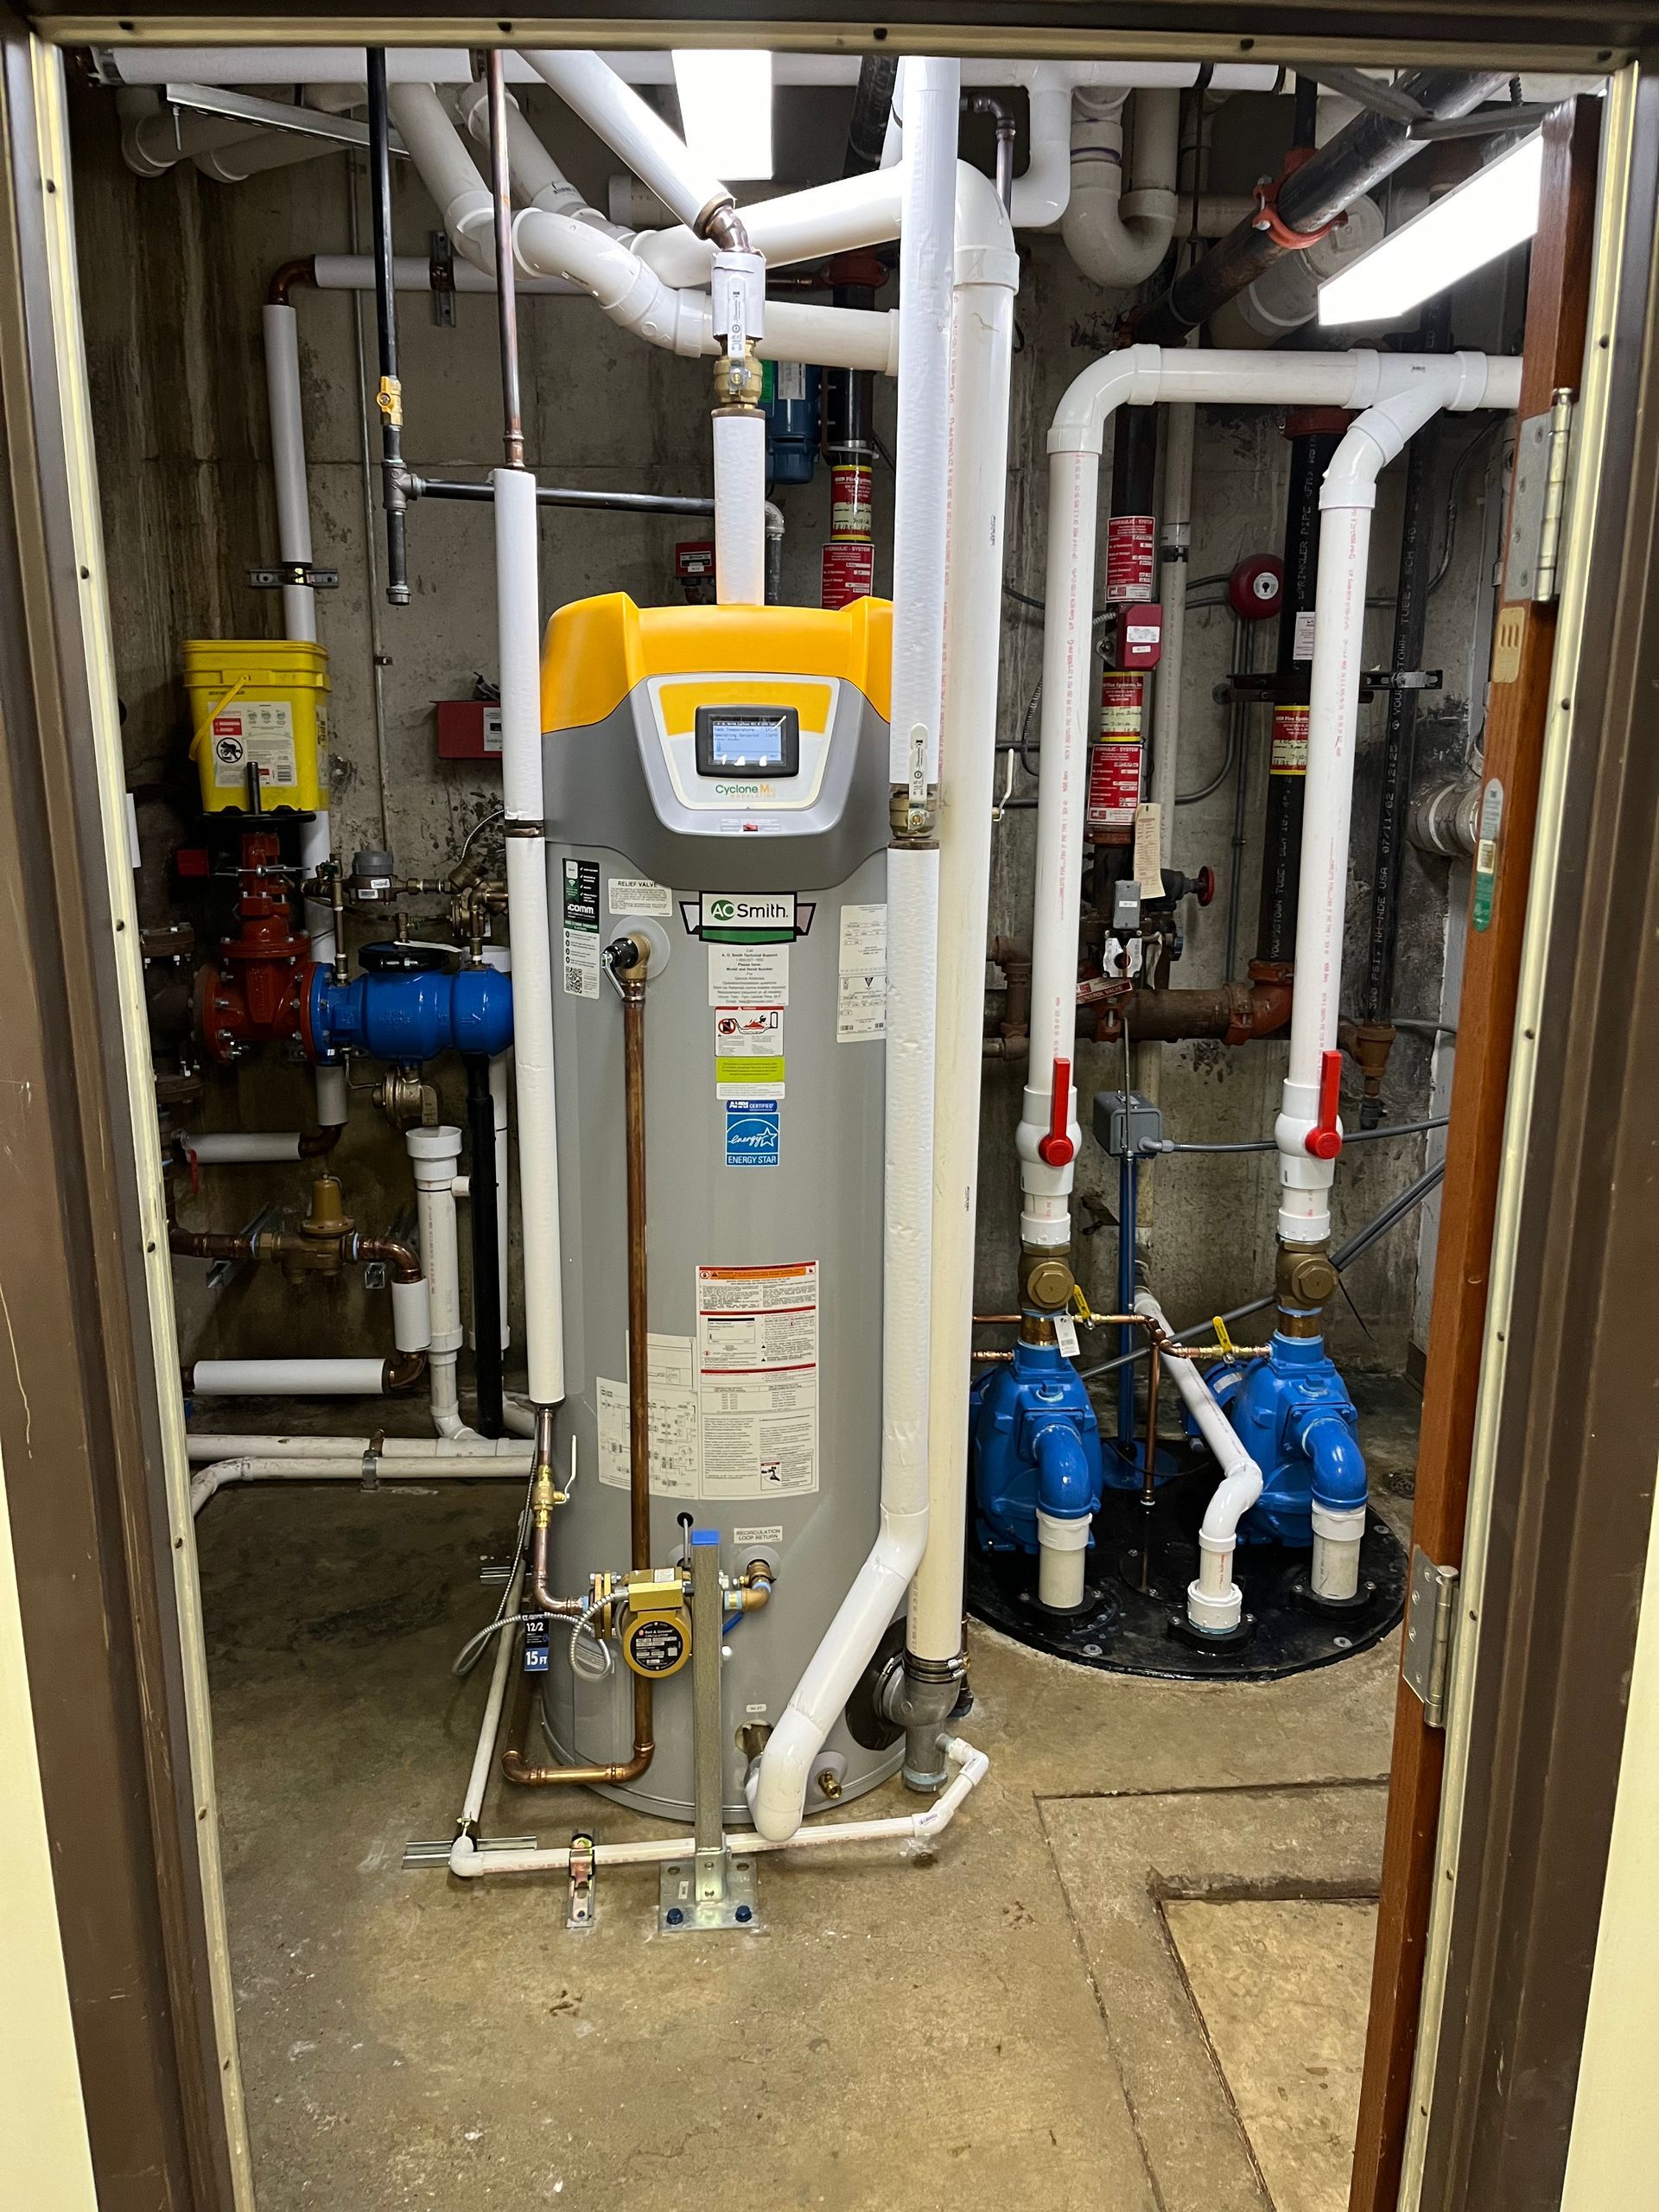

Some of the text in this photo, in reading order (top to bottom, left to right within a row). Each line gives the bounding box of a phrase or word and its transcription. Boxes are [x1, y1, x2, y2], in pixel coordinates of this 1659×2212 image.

[1387, 744, 1398, 785] 12:25
[715, 784, 759, 796] Cyclone
[1379, 867, 1388, 889] USA
[728, 1135, 762, 1148] energy
[728, 1155, 777, 1164] ENERGY STAR
[525, 1621, 544, 1632] 12/2
[525, 1650, 548, 1666] 15 FT
